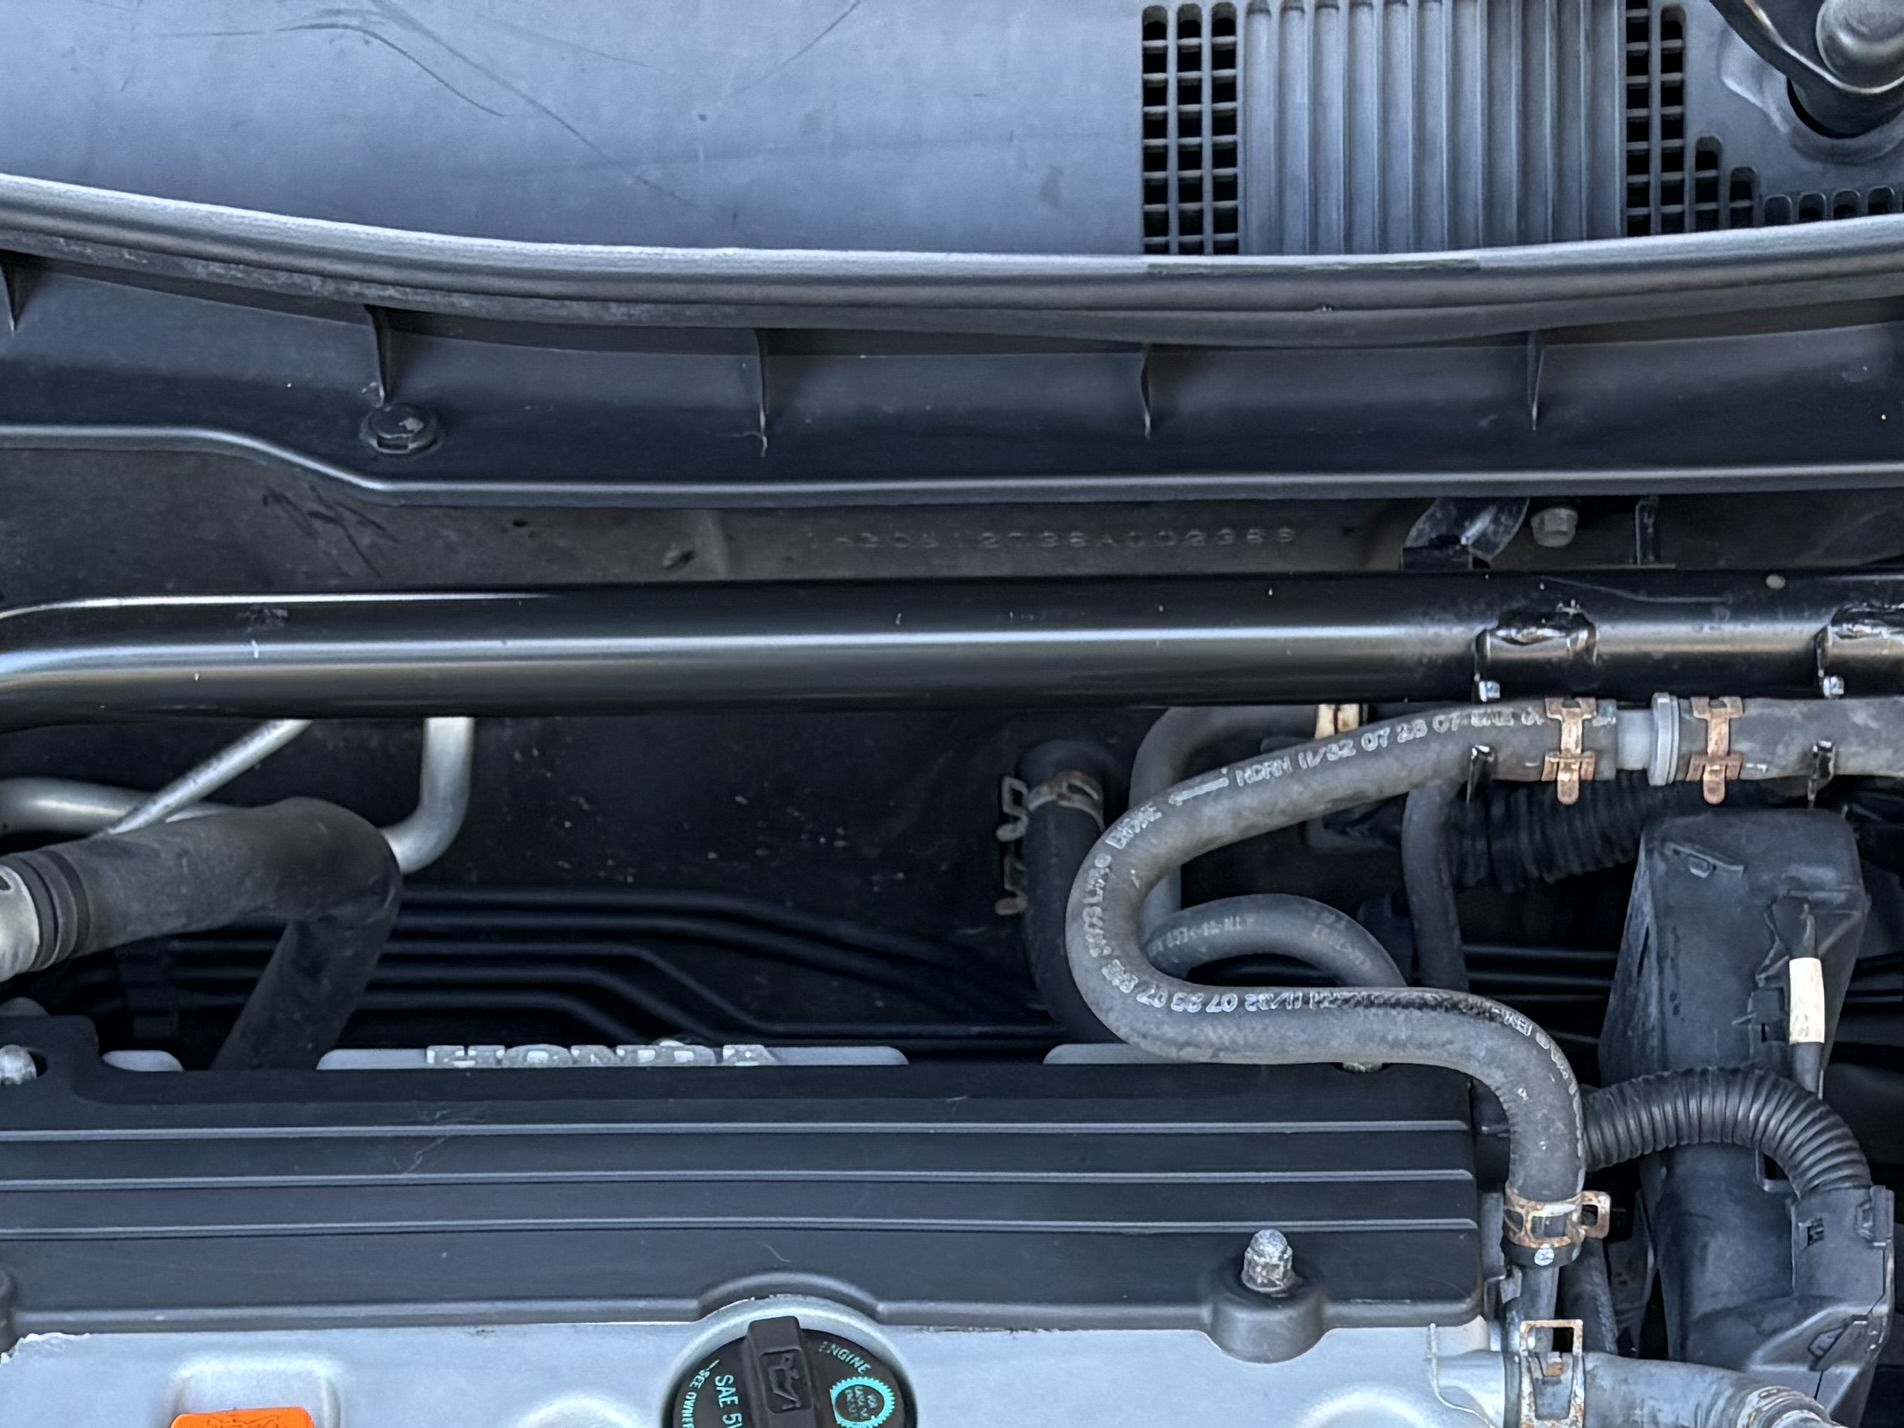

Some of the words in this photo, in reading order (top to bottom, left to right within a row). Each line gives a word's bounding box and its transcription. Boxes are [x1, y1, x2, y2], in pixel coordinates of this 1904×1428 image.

[1359, 727, 1393, 754] 07
[1204, 991, 1238, 1014] 07
[818, 1341, 871, 1374] ENGINE
[689, 1369, 710, 1388] SEE
[714, 1374, 737, 1408] SAE
